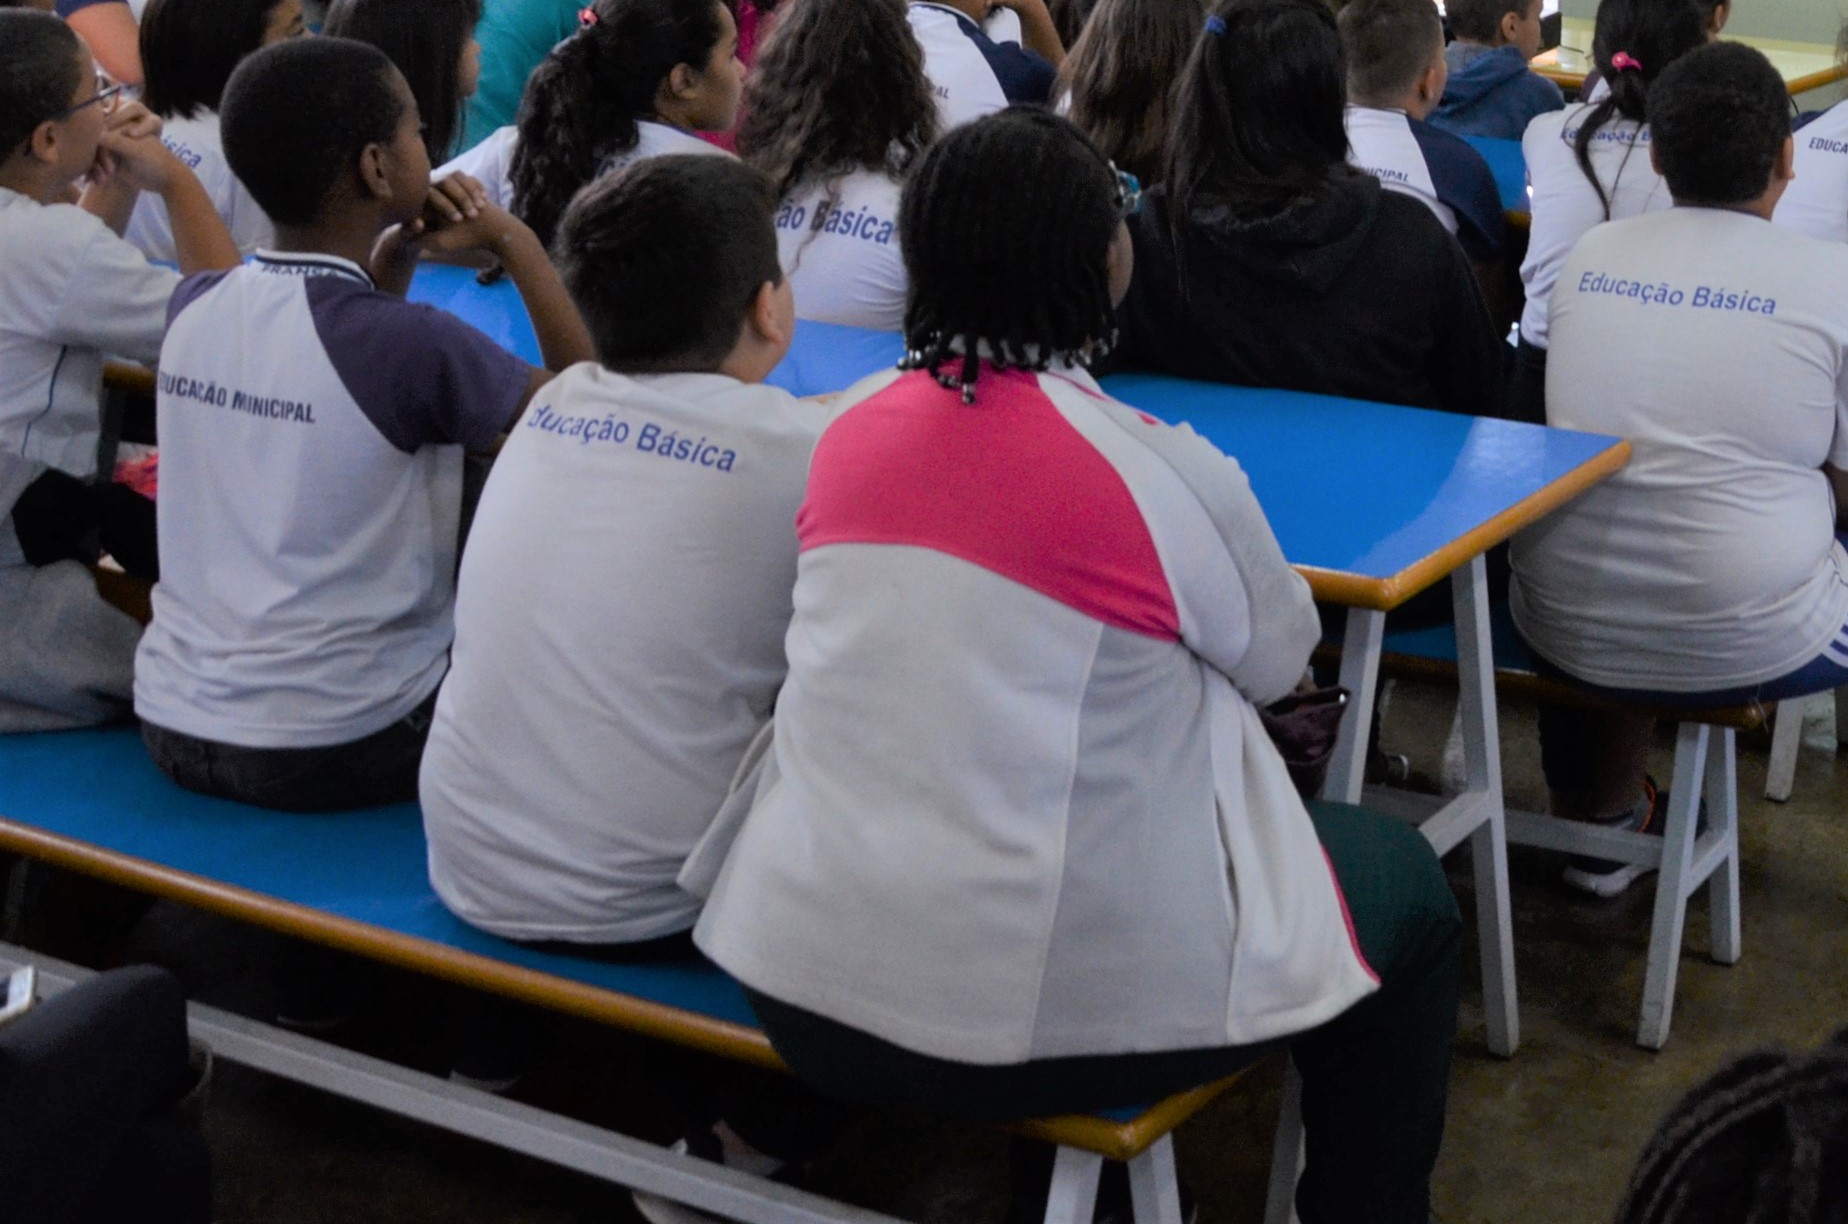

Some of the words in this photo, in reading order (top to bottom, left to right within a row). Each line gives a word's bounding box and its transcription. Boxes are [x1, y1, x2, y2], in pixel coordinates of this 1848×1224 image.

[1578, 272, 1684, 305] Educação
[1692, 285, 1777, 315] Básica
[527, 405, 629, 445] ducação
[637, 422, 737, 472] Básica
